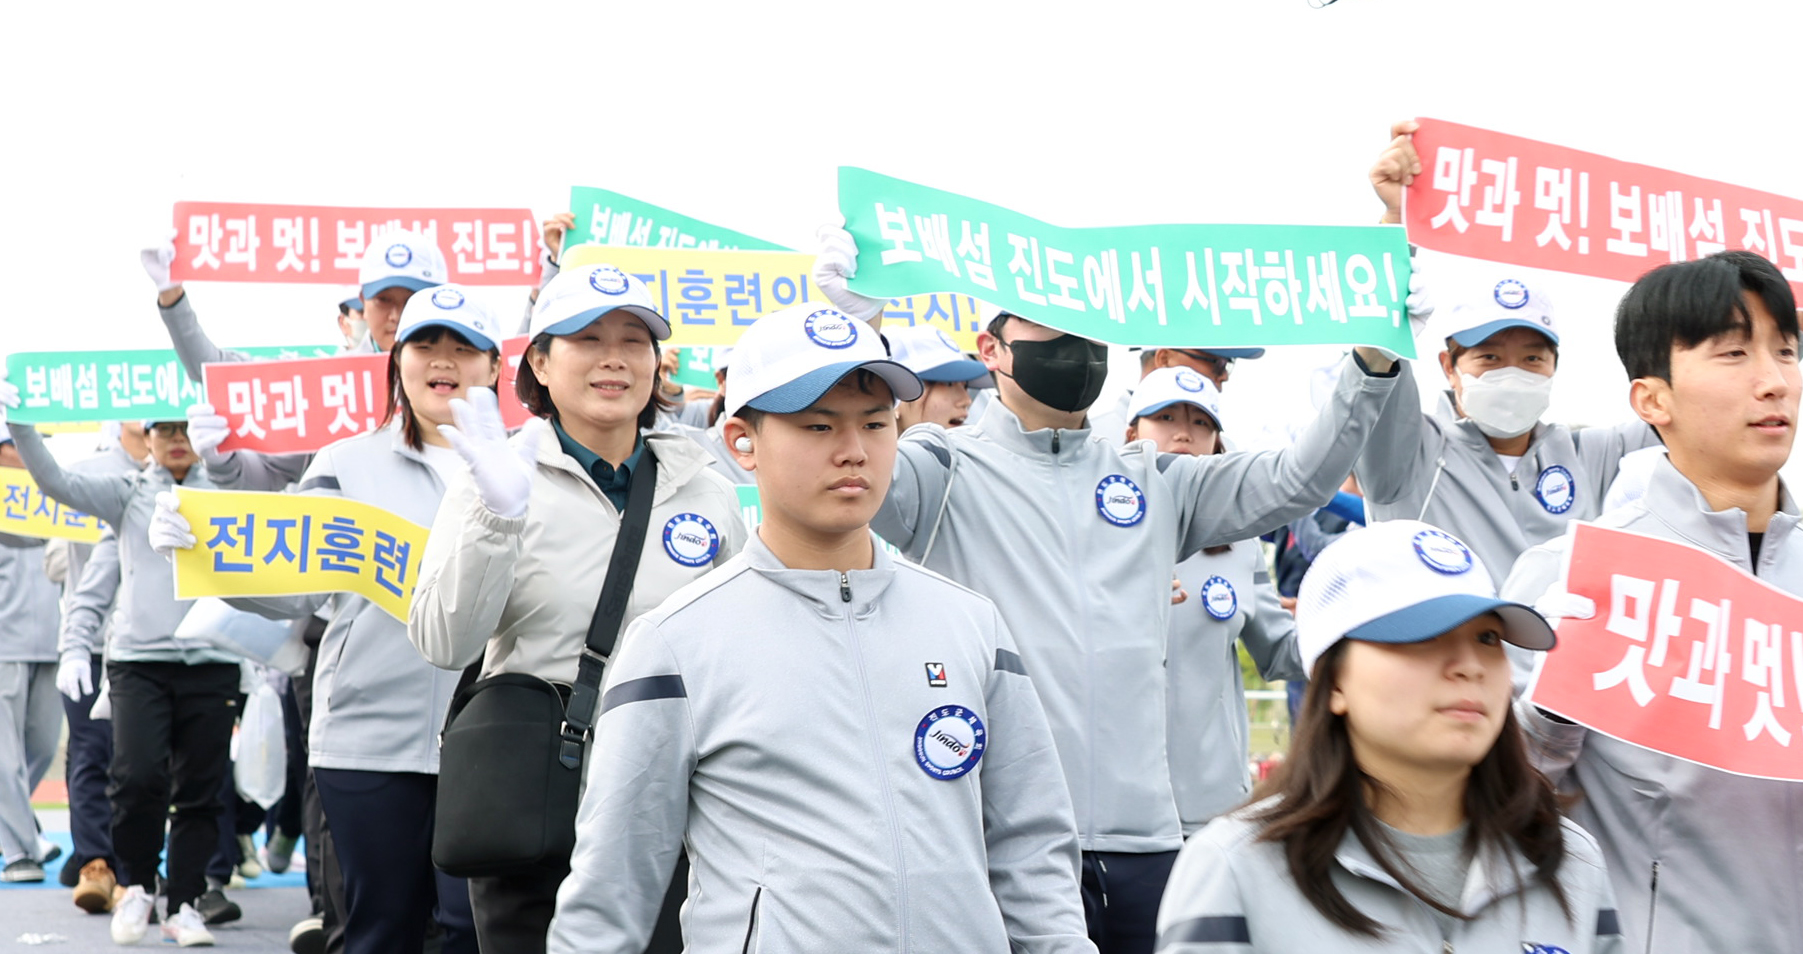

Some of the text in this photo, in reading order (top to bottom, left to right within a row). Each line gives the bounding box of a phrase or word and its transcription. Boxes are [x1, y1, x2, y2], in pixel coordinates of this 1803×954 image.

[1431, 146, 1521, 242] 맛과
[1534, 166, 1590, 255] 멋!
[1606, 181, 1727, 263] 보배섬
[188, 213, 260, 272] 맛과
[272, 216, 320, 273] 멋!
[452, 218, 534, 274] 진도!
[874, 202, 1401, 328] 보배섬 진도에서 시작하세요!
[25, 363, 99, 410] 보배섬
[227, 369, 376, 440] 맛과 멋!
[205, 513, 418, 599] 전지훈련
[1593, 573, 1732, 730] 맛과
[929, 729, 961, 754] Jindo
